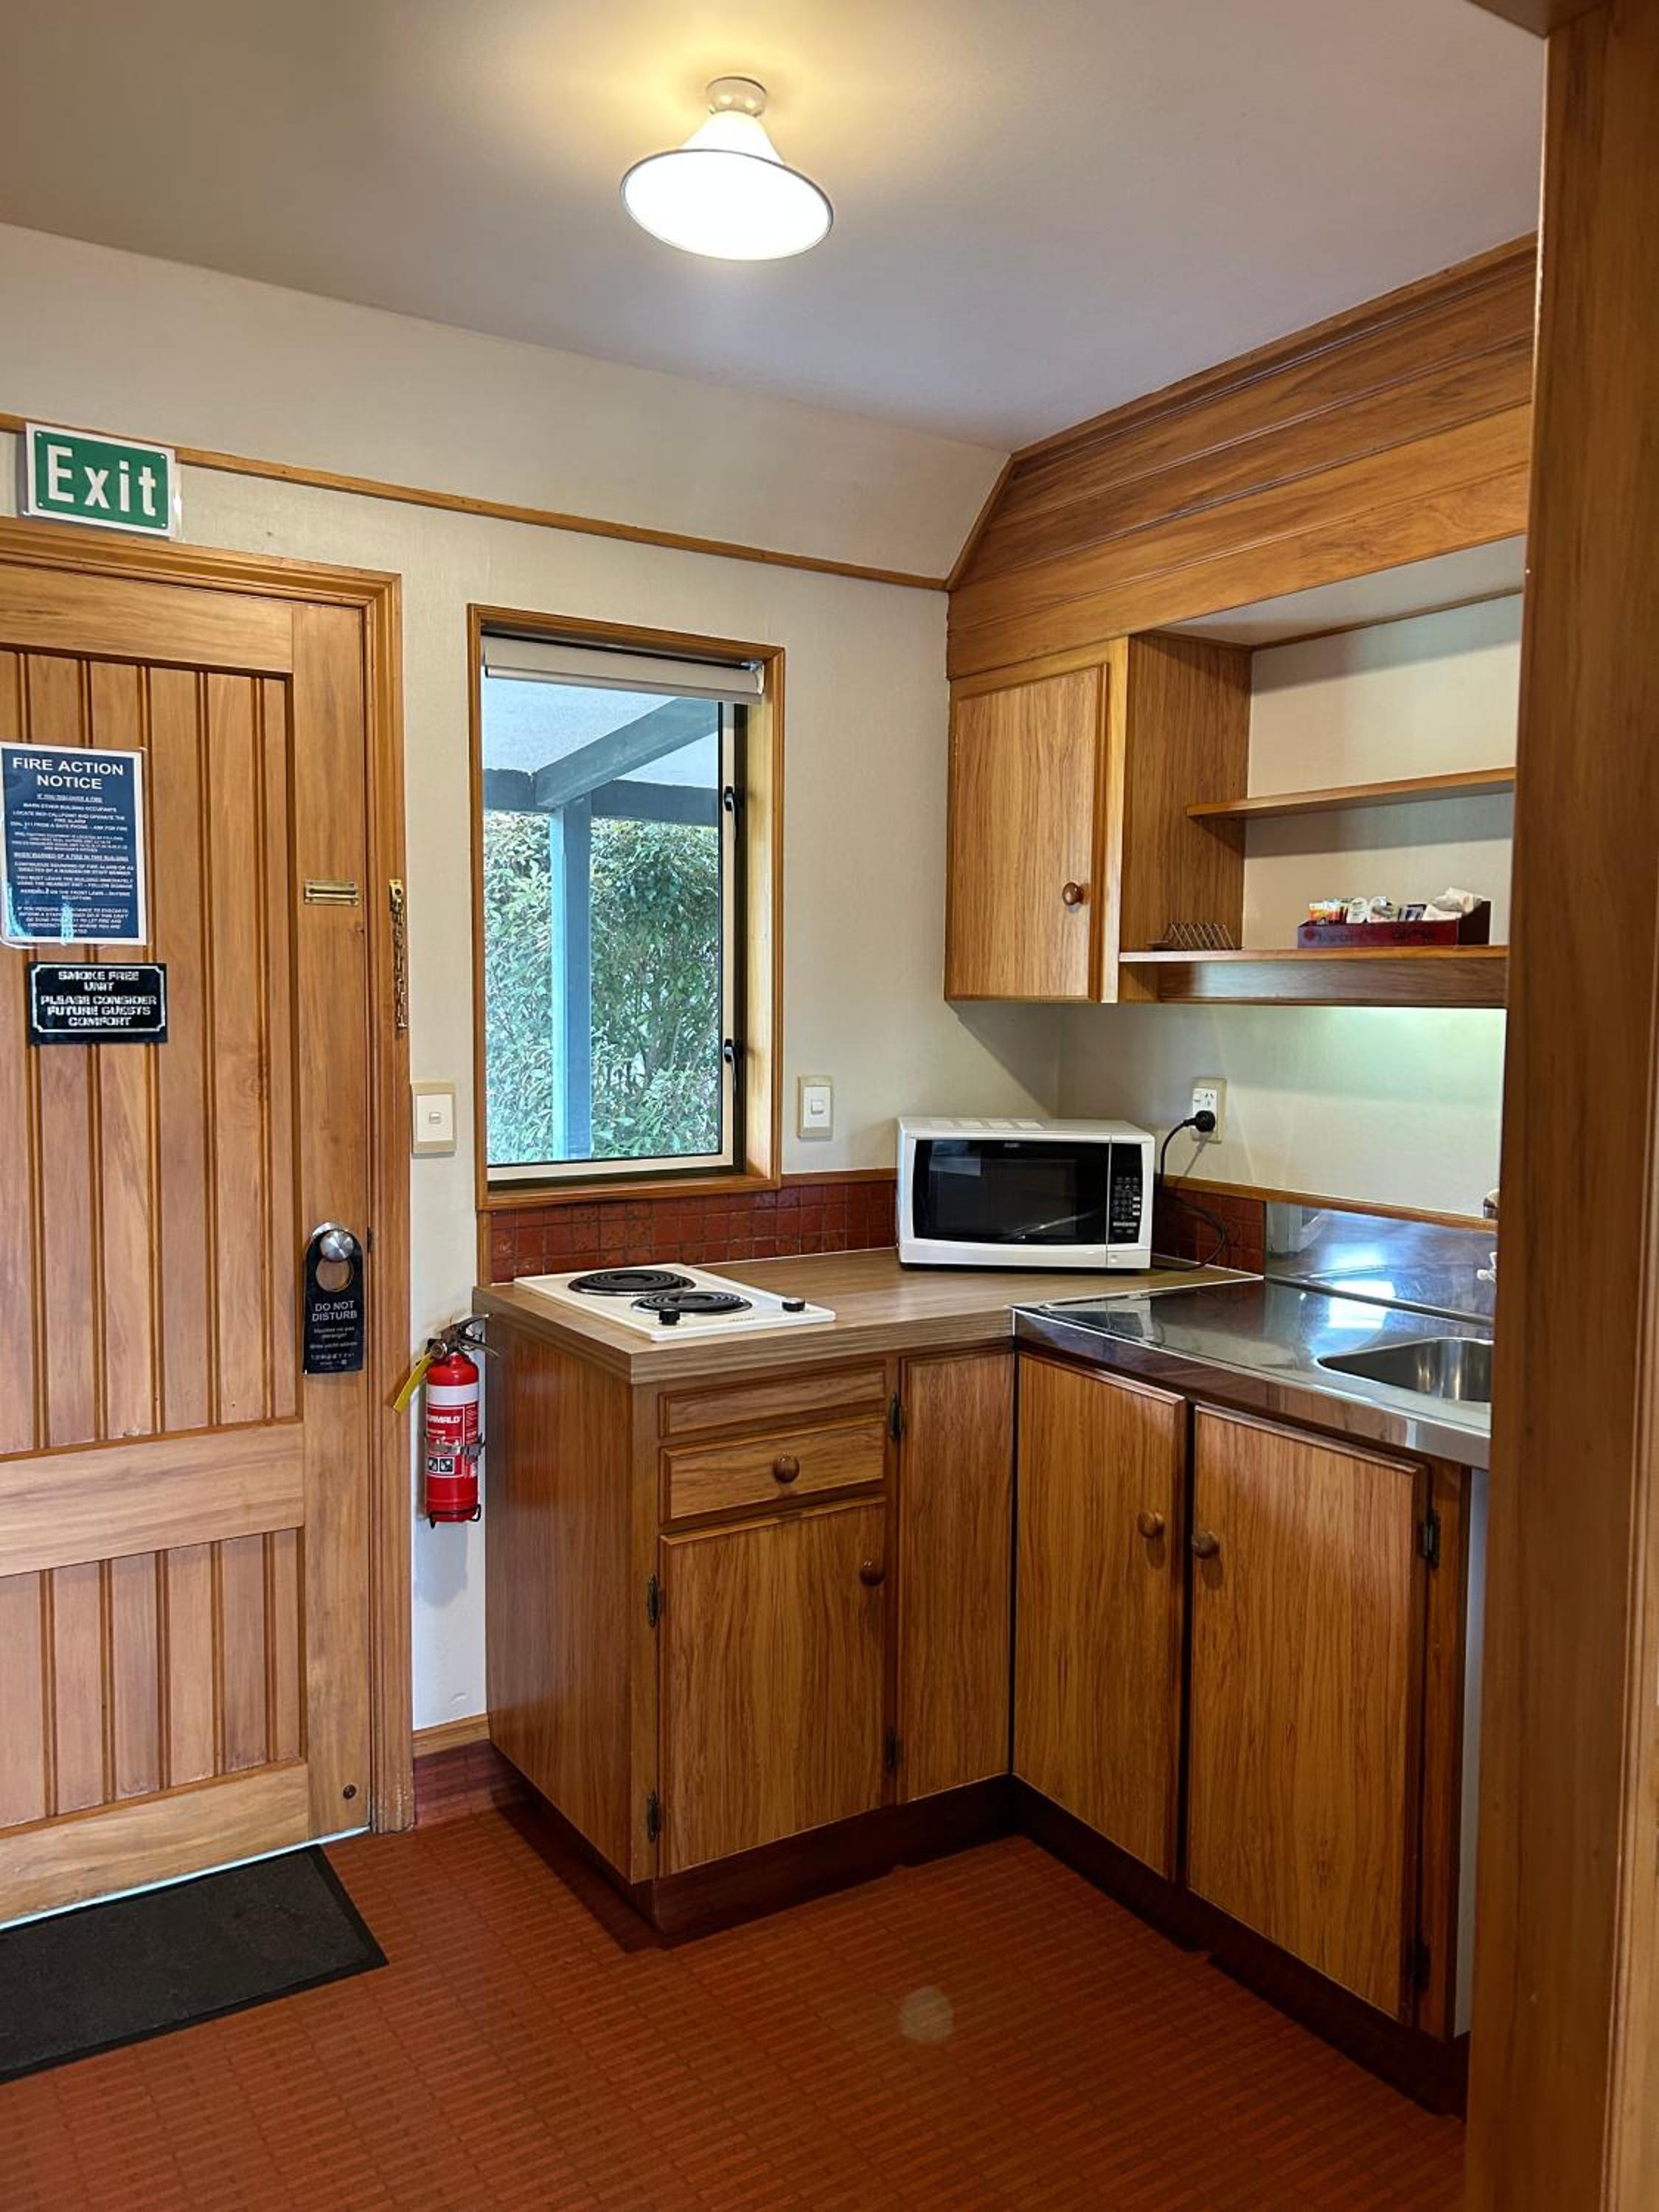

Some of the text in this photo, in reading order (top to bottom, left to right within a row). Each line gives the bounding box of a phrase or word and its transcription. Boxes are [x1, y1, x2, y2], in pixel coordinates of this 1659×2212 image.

[46, 444, 156, 517] Exit
[13, 757, 124, 775] FIRE ACTION
[36, 775, 102, 790] NOTICE
[58, 971, 139, 981] SMOKE FREE
[83, 981, 114, 992] UNIT
[41, 995, 157, 1005] PLEASE CONSIDER
[47, 1005, 151, 1015] FUTURE GUESTS
[68, 1017, 132, 1026] COMFORT
[315, 1300, 355, 1312] DO NOT
[312, 1310, 358, 1322] DISTURB
